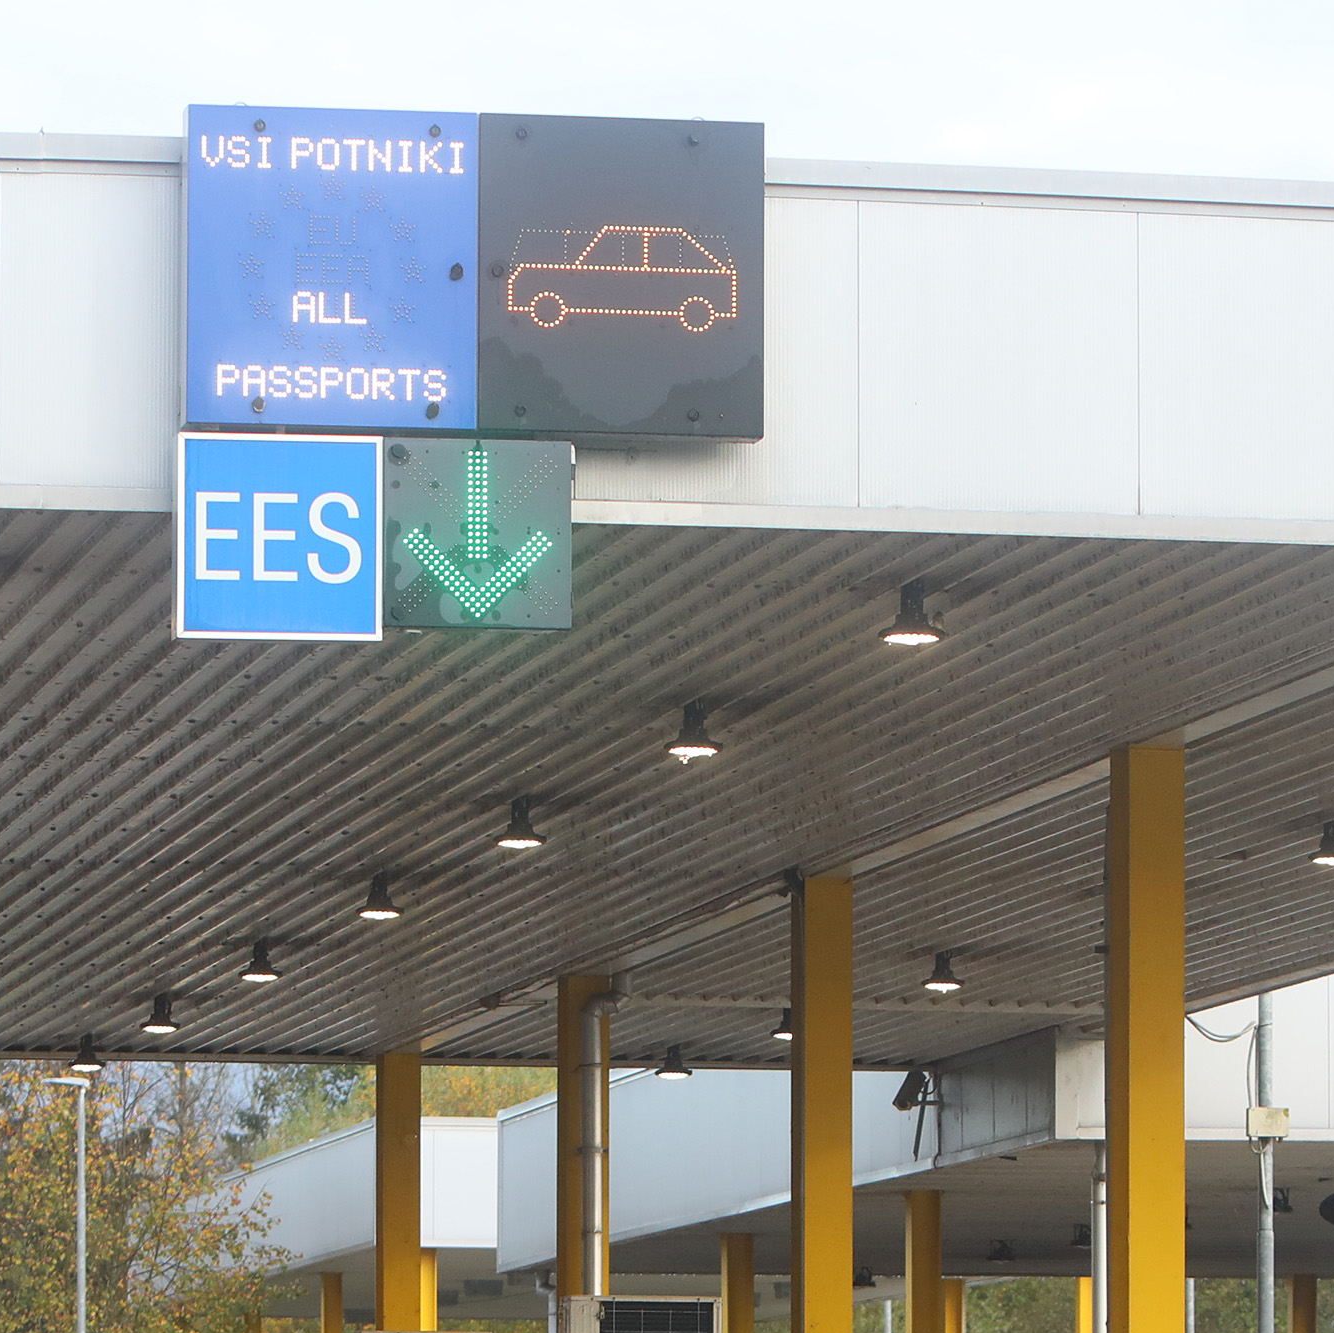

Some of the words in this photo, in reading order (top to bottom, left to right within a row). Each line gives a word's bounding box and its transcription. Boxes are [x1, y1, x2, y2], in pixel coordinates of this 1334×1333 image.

[201, 135, 271, 169] VSI
[291, 137, 465, 176] POTNIKI
[292, 291, 367, 324] ALL
[216, 364, 447, 404] PASSPORTS
[195, 491, 362, 584] EES
